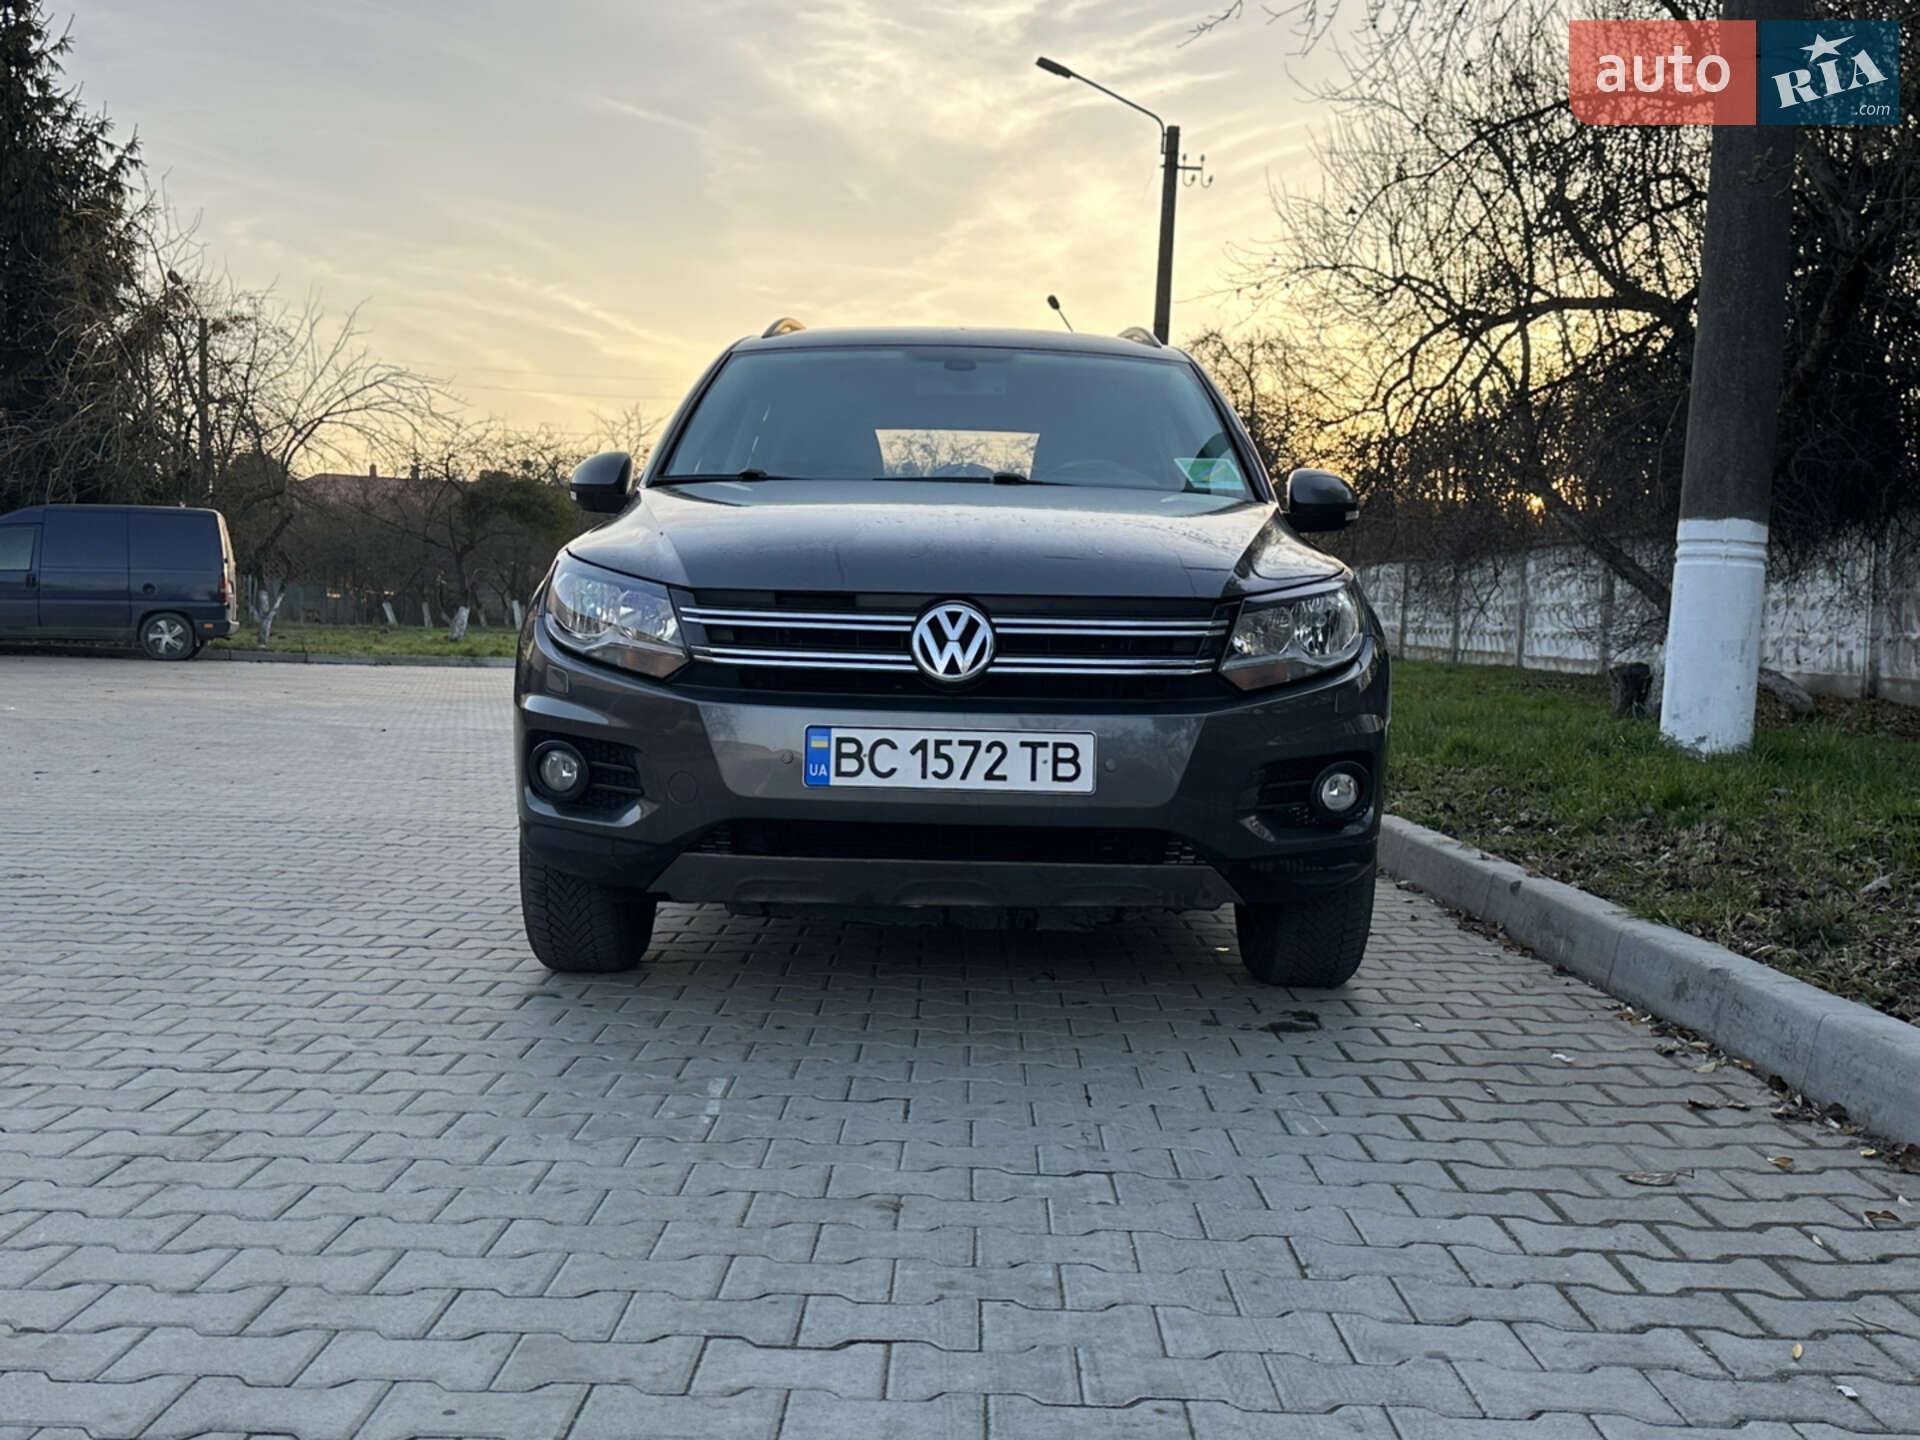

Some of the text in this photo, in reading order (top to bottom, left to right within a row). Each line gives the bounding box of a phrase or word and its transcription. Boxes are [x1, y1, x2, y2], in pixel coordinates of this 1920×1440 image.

[918, 606, 988, 676] VW
[809, 763, 828, 777] UA
[834, 736, 1082, 783] BC 1572 TB
